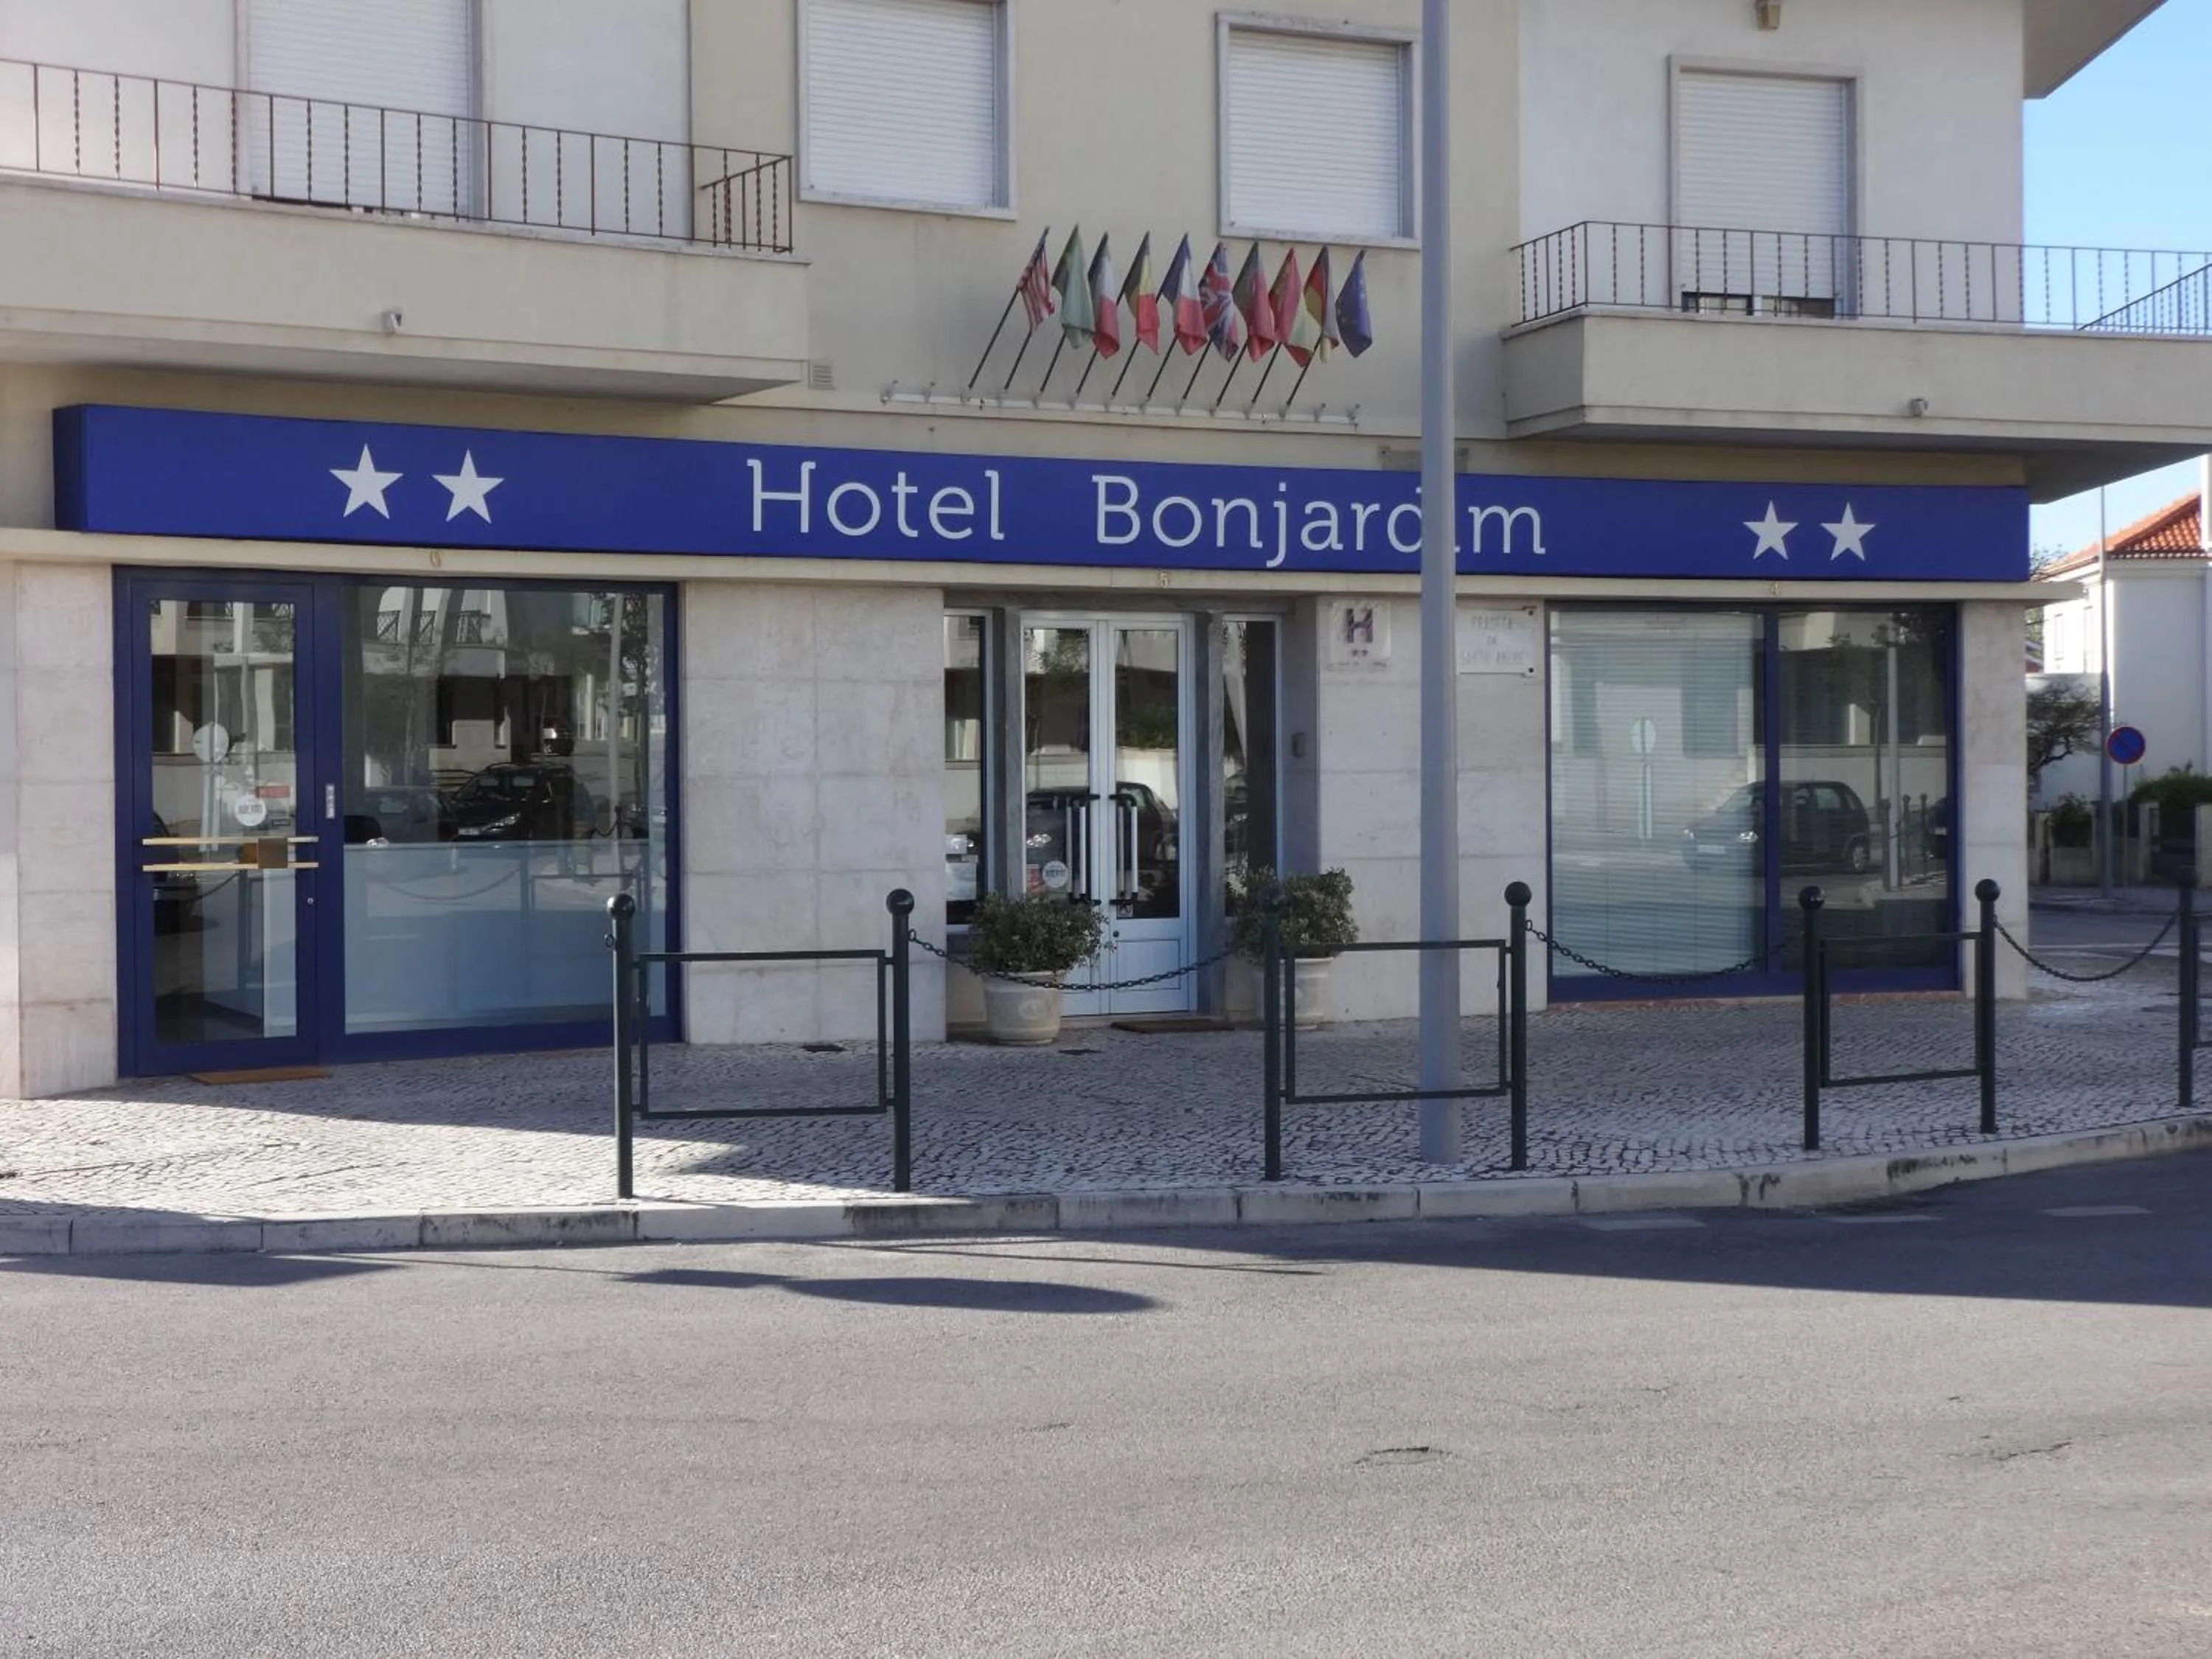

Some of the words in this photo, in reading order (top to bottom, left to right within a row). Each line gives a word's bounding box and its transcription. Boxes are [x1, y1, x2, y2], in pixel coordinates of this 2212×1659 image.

[747, 459, 1005, 540] Hotel
[1091, 474, 1546, 568] Bonjardm
[1345, 608, 1374, 644] H
